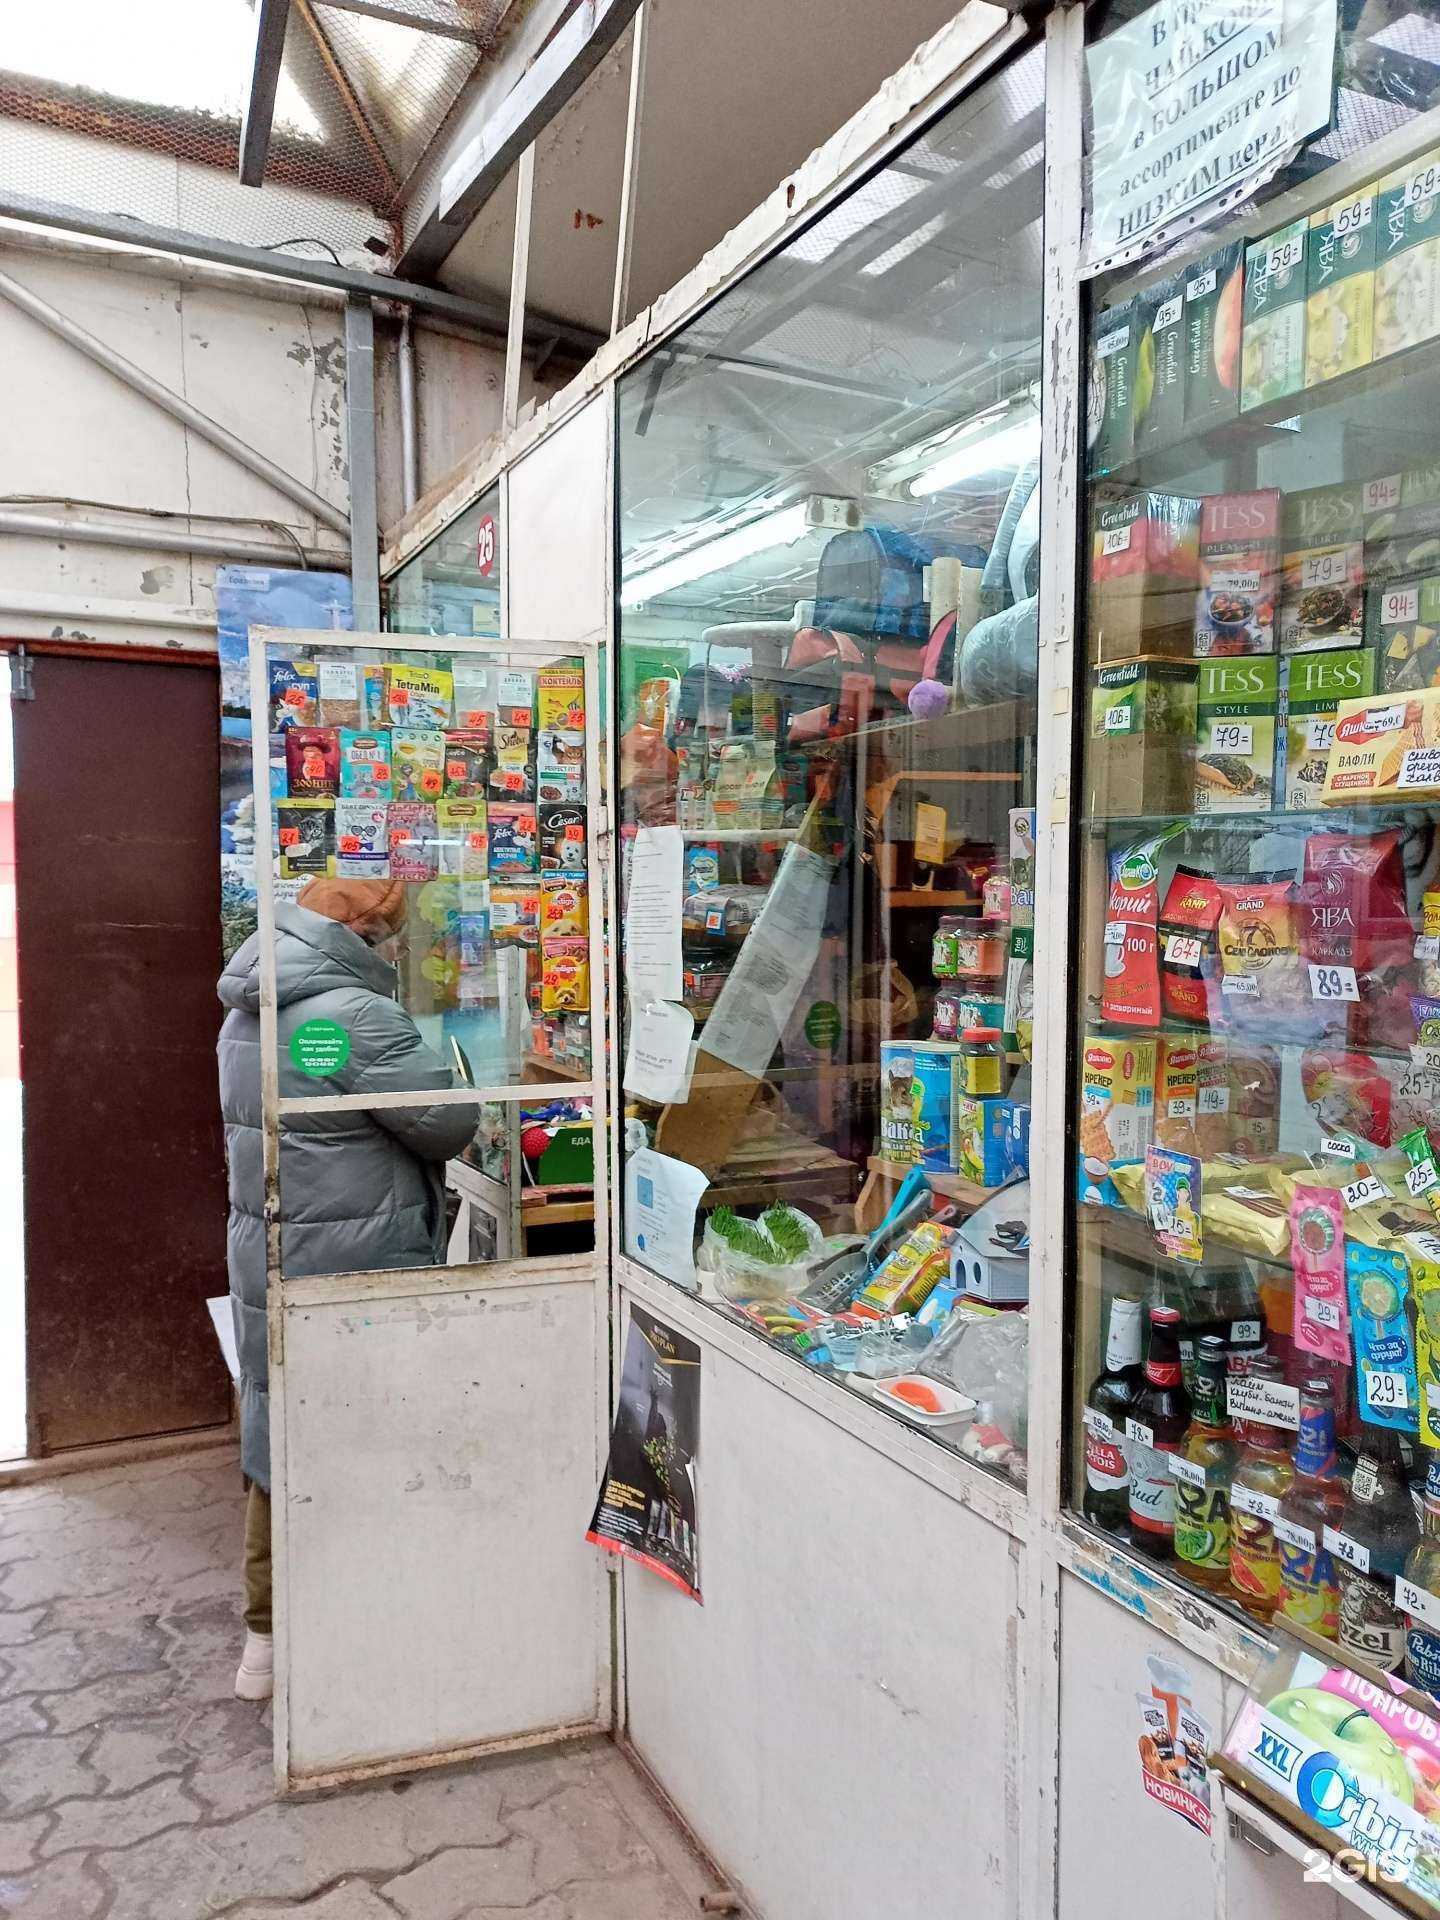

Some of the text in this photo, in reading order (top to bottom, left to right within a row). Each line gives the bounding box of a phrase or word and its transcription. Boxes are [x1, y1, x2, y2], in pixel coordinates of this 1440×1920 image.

[1152, 20, 1167, 48] В
[1151, 30, 1280, 137] БОЛЬШОМ
[1120, 65, 1300, 198] ассортименте по
[1118, 154, 1222, 240] НИЗКИМ
[1166, 331, 1178, 384] Greenfield
[1190, 319, 1202, 374] Greenfield
[1116, 356, 1128, 408] Greenfield
[1101, 500, 1140, 527] Greenfield
[1210, 501, 1266, 532] TESS
[478, 521, 494, 567] 25
[273, 671, 296, 684] felix
[395, 678, 440, 695] TetraMin
[541, 677, 582, 687] КОКТЕЙЛЬ
[1100, 664, 1140, 685] Greenfield
[1202, 665, 1266, 695] TESS
[1301, 661, 1362, 691] TESS
[1215, 705, 1250, 714] STYLE
[1216, 726, 1249, 748] 79=
[1338, 753, 1375, 768] ВАФЛИ
[549, 813, 580, 830] Cesar
[1236, 901, 1264, 911] GRAND
[1311, 907, 1355, 928] ЯВА
[1126, 938, 1146, 952] 100
[1317, 968, 1354, 996] 89=
[1085, 1072, 1113, 1087] КРЕКЕР
[1167, 1073, 1197, 1087] КРЕКЕР
[571, 1137, 591, 1146] ЕДА
[1348, 1182, 1382, 1203] 20=
[1370, 1375, 1404, 1403] 29=
[1130, 1477, 1164, 1506] Bud
[1254, 1731, 1293, 1773] XXL
[1297, 1751, 1419, 1867] Orbit
